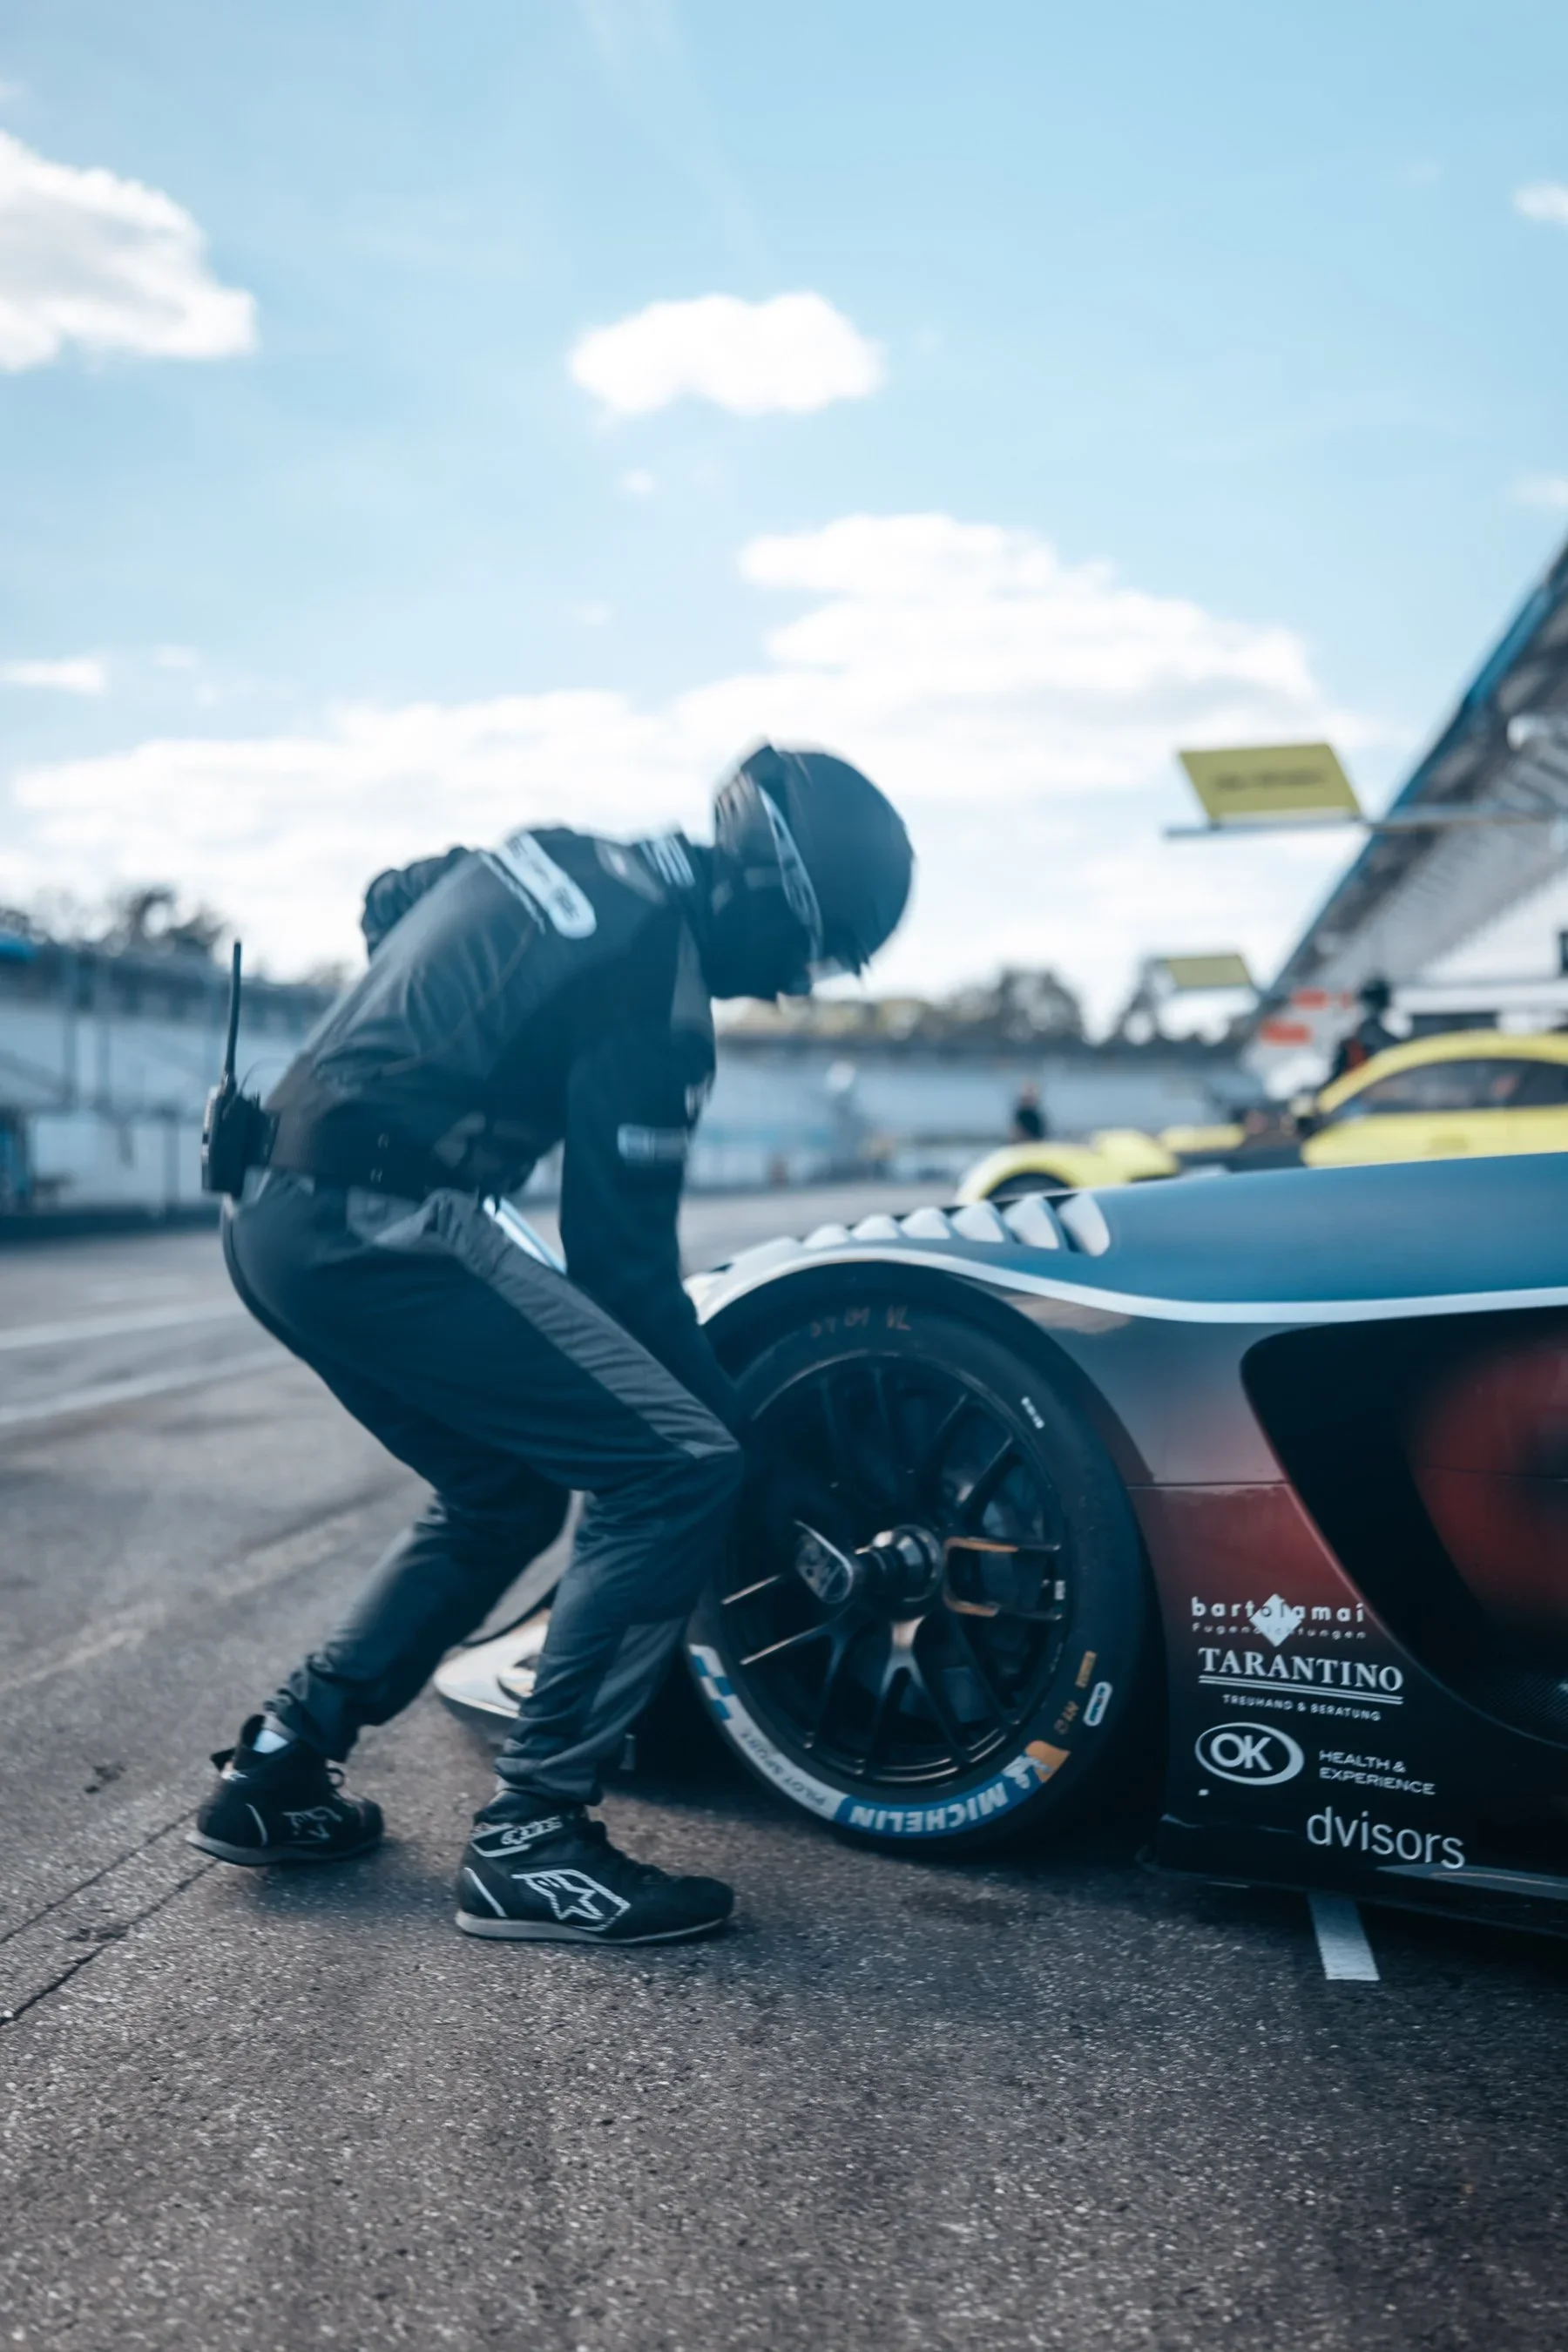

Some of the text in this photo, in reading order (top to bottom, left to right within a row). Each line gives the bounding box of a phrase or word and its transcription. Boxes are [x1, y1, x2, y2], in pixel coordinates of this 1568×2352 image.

[1198, 1646, 1404, 1692] TARANTINO
[1222, 1693, 1382, 1722] TREUHAND & BERATUNG
[1209, 1732, 1274, 1772] OK
[1318, 1748, 1407, 1774] HEALTH &
[1318, 1767, 1437, 1795] EXPERIENCE
[848, 1781, 1010, 1834] MICHELIN
[1307, 1805, 1466, 1869] dvisors
